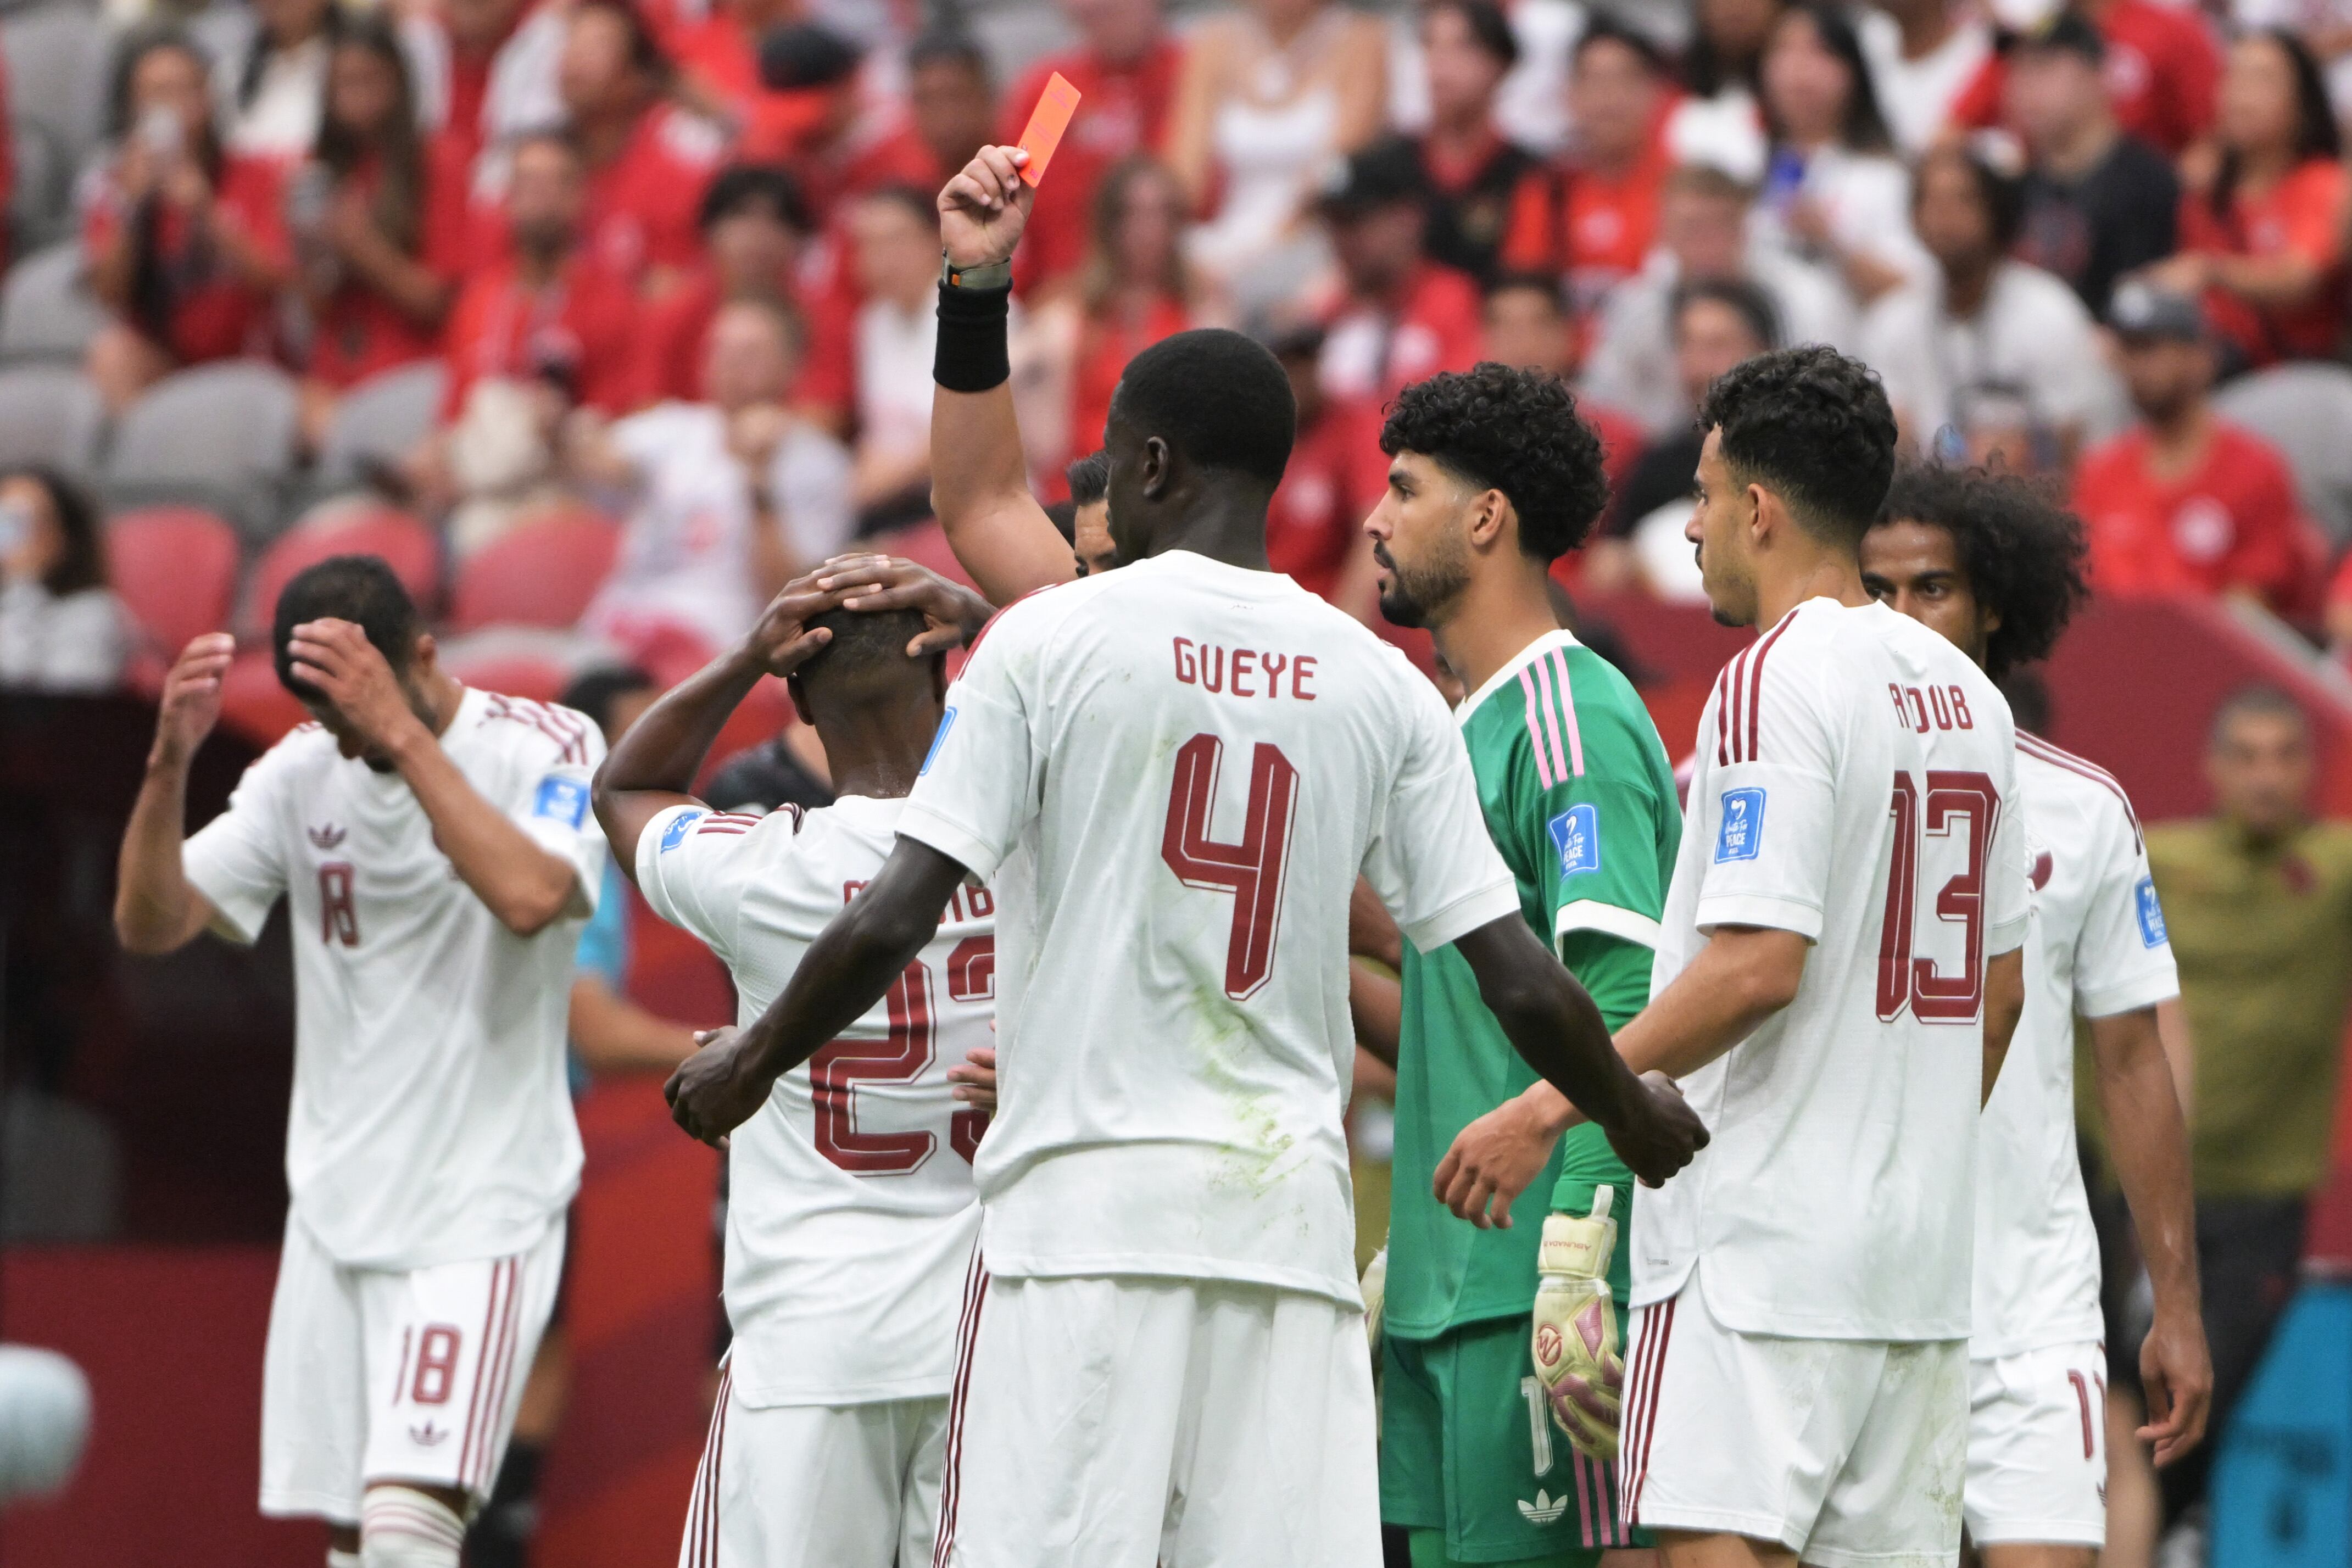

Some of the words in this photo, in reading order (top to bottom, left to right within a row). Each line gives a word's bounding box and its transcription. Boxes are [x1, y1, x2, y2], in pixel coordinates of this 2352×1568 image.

[1174, 637, 1317, 700] GUEYE
[1161, 733, 1300, 1001] 4
[1563, 845, 1584, 865] PEACE
[1726, 833, 1746, 848] PEACE
[1876, 770, 2001, 1025] 13
[392, 1323, 462, 1407] 18
[1521, 1376, 1553, 1476] 1
